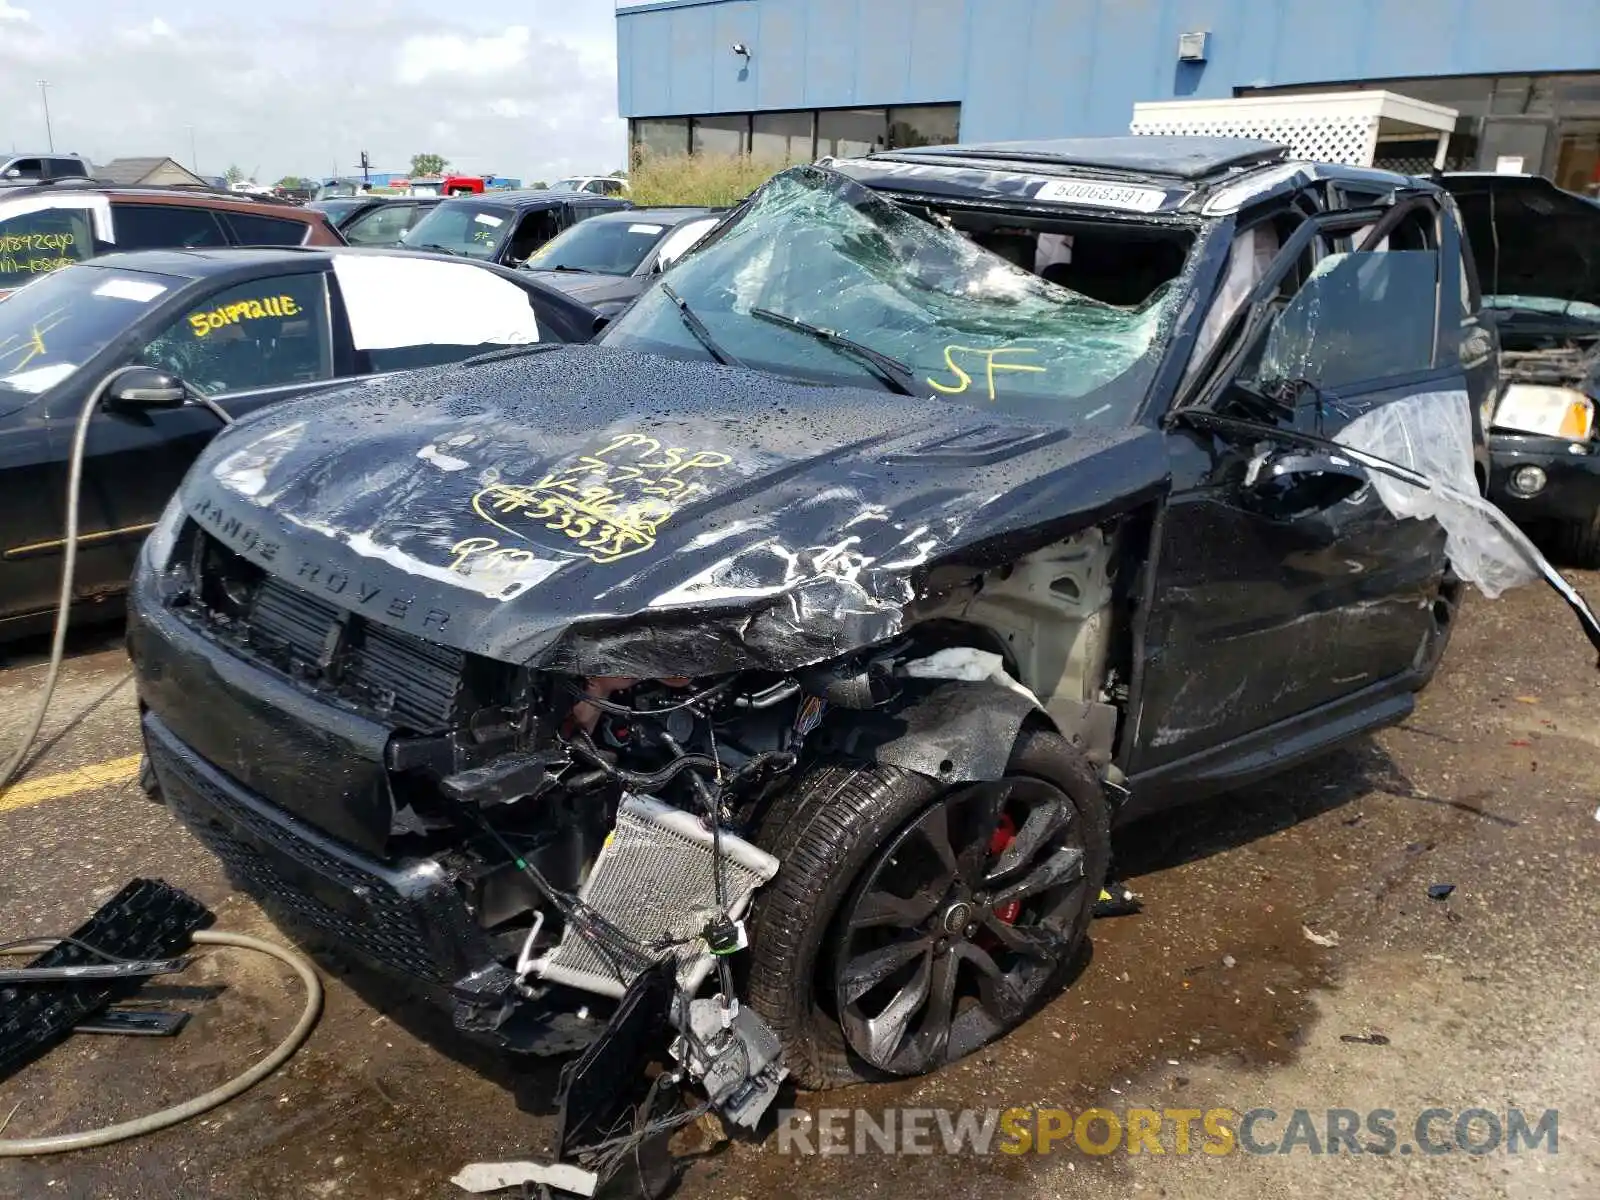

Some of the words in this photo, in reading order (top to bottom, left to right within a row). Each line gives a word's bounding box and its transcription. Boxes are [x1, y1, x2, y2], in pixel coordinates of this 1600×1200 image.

[926, 344, 1047, 401] SF
[193, 498, 282, 562] RANGE
[297, 559, 450, 633] ROVER
